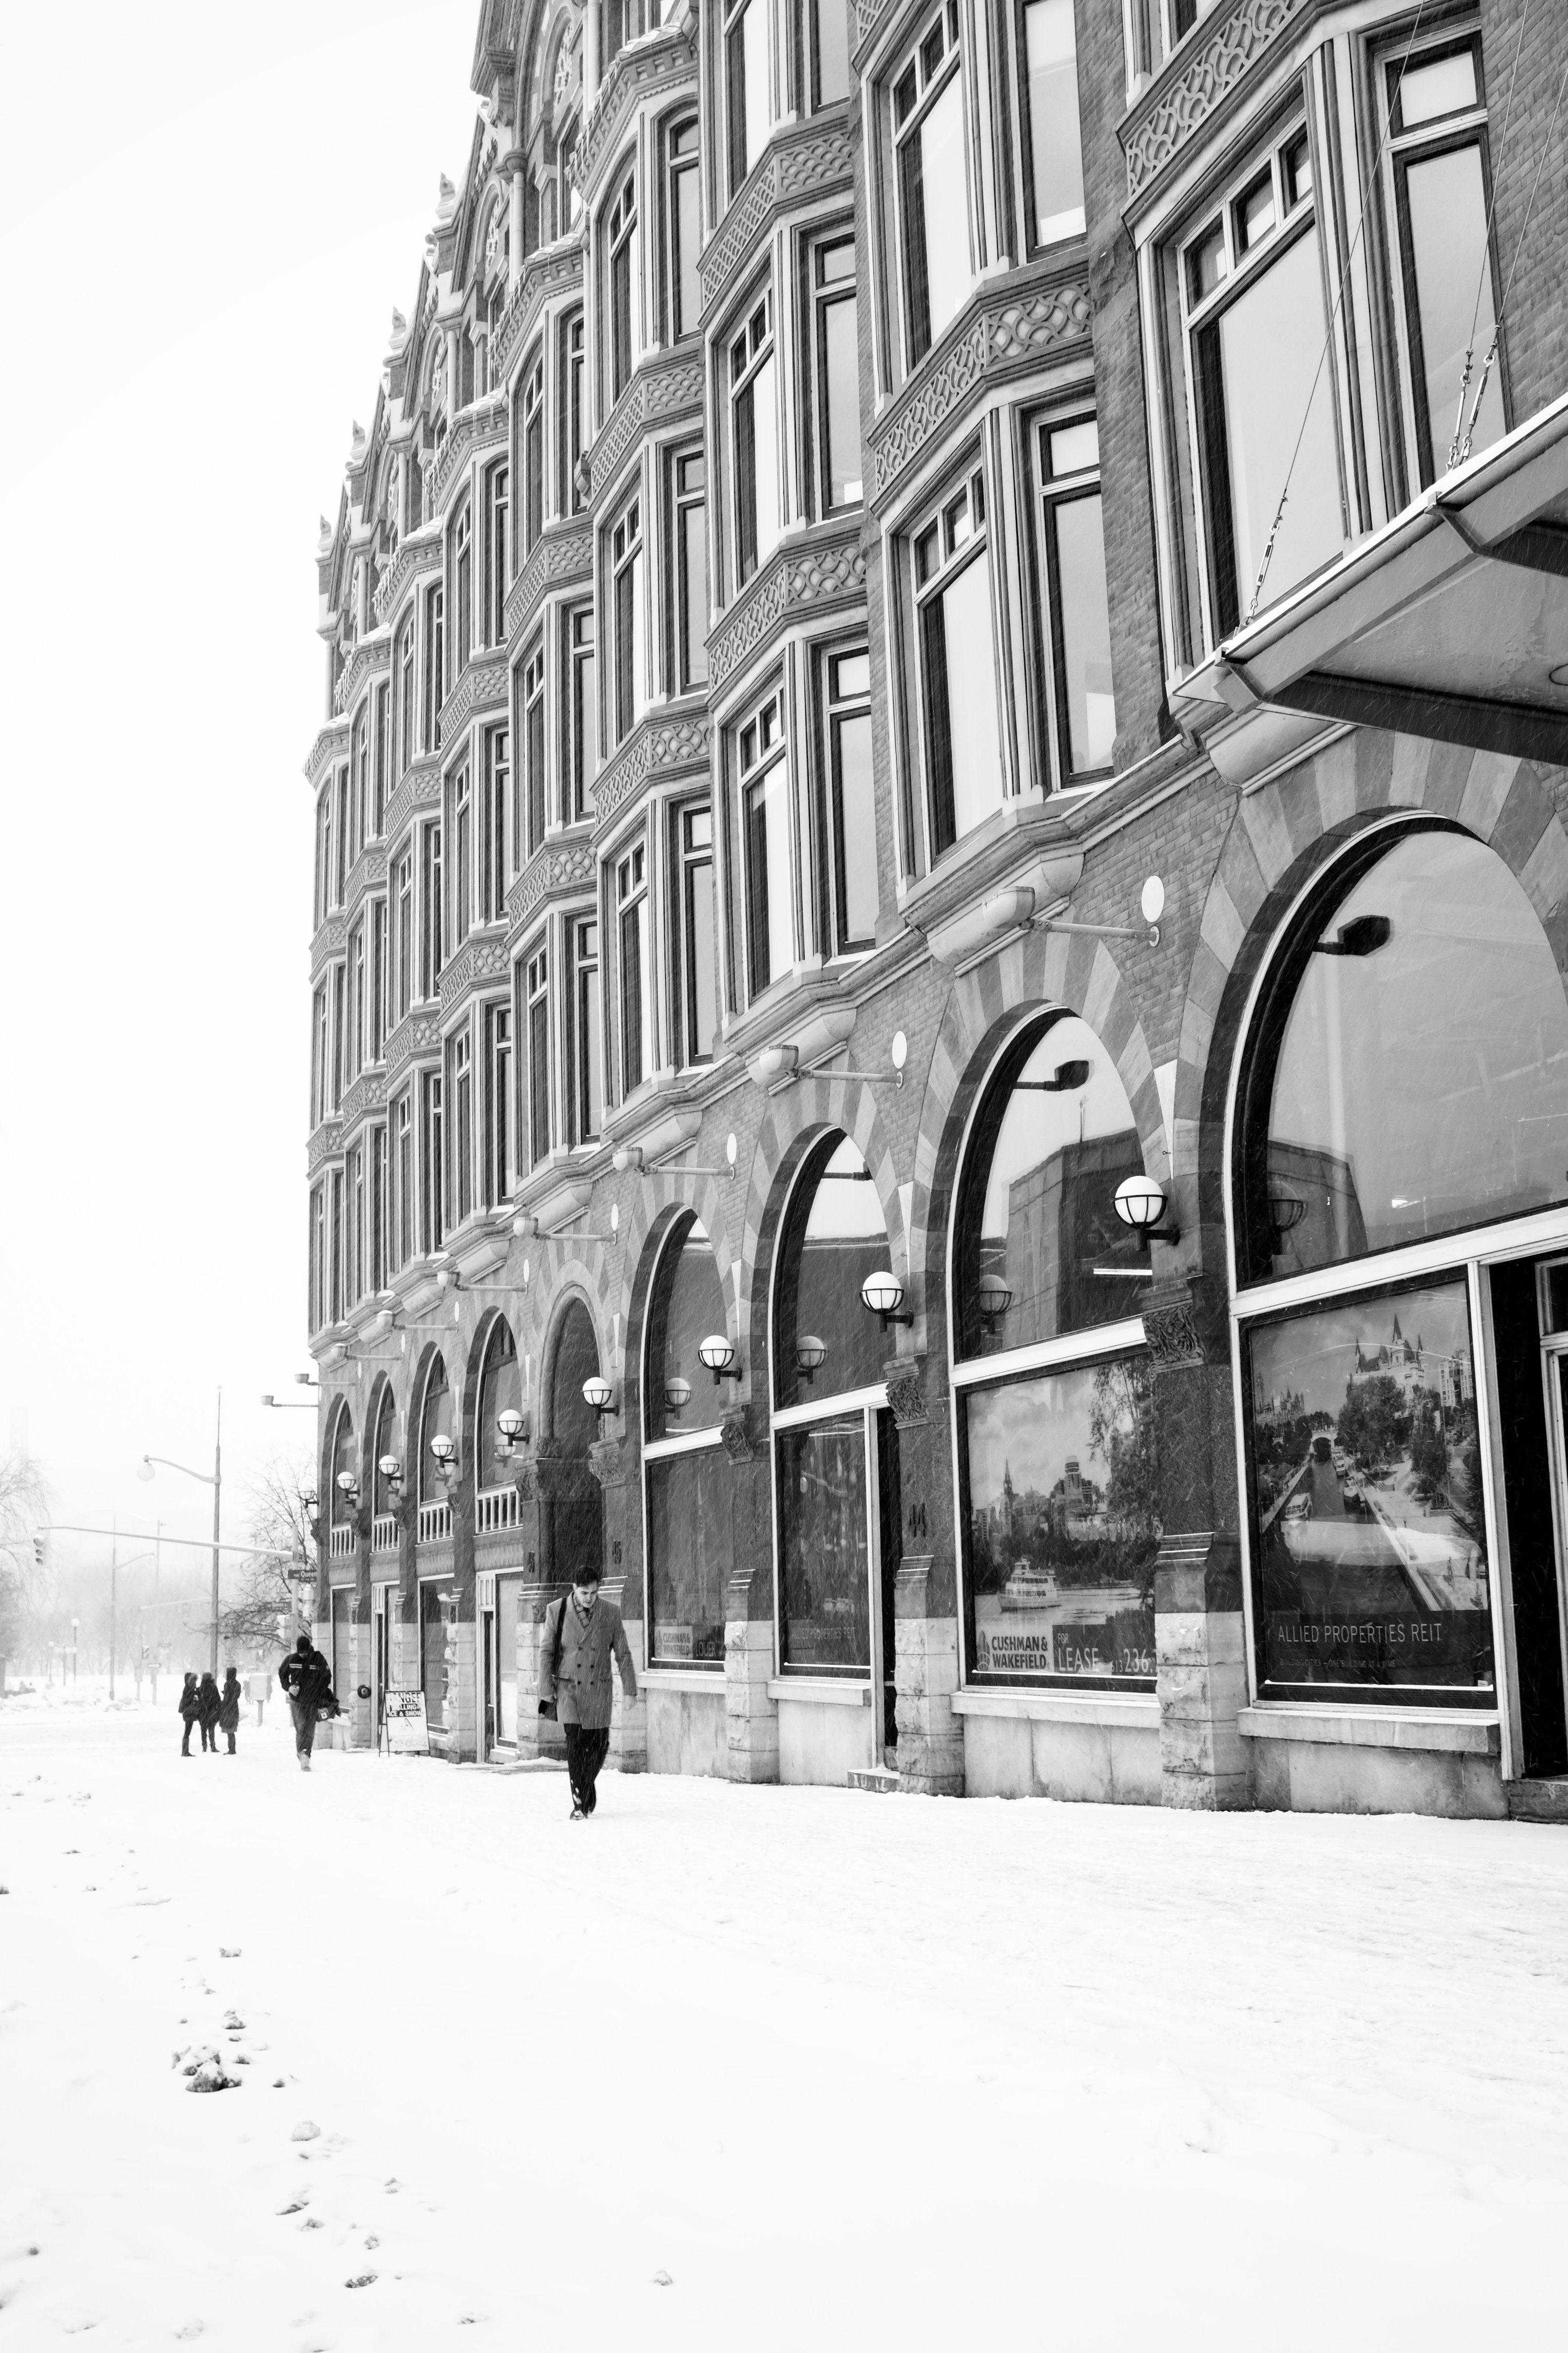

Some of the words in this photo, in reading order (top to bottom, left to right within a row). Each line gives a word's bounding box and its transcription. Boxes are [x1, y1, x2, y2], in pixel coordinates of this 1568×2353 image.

[1057, 1633, 1069, 1644] FOR
[1278, 1625, 1319, 1642] ALLIED
[1324, 1624, 1406, 1644] PROPERTIES
[1411, 1623, 1442, 1642] REIT
[991, 1635, 1040, 1651] CUSHMAN
[1041, 1636, 1048, 1651] &
[992, 1653, 1047, 1669] WAKEFIELD
[1057, 1647, 1100, 1672] LEASE
[1111, 1660, 1123, 1673] 613
[1123, 1648, 1157, 1673] 236.
[1341, 1660, 1367, 1668] BUILDING
